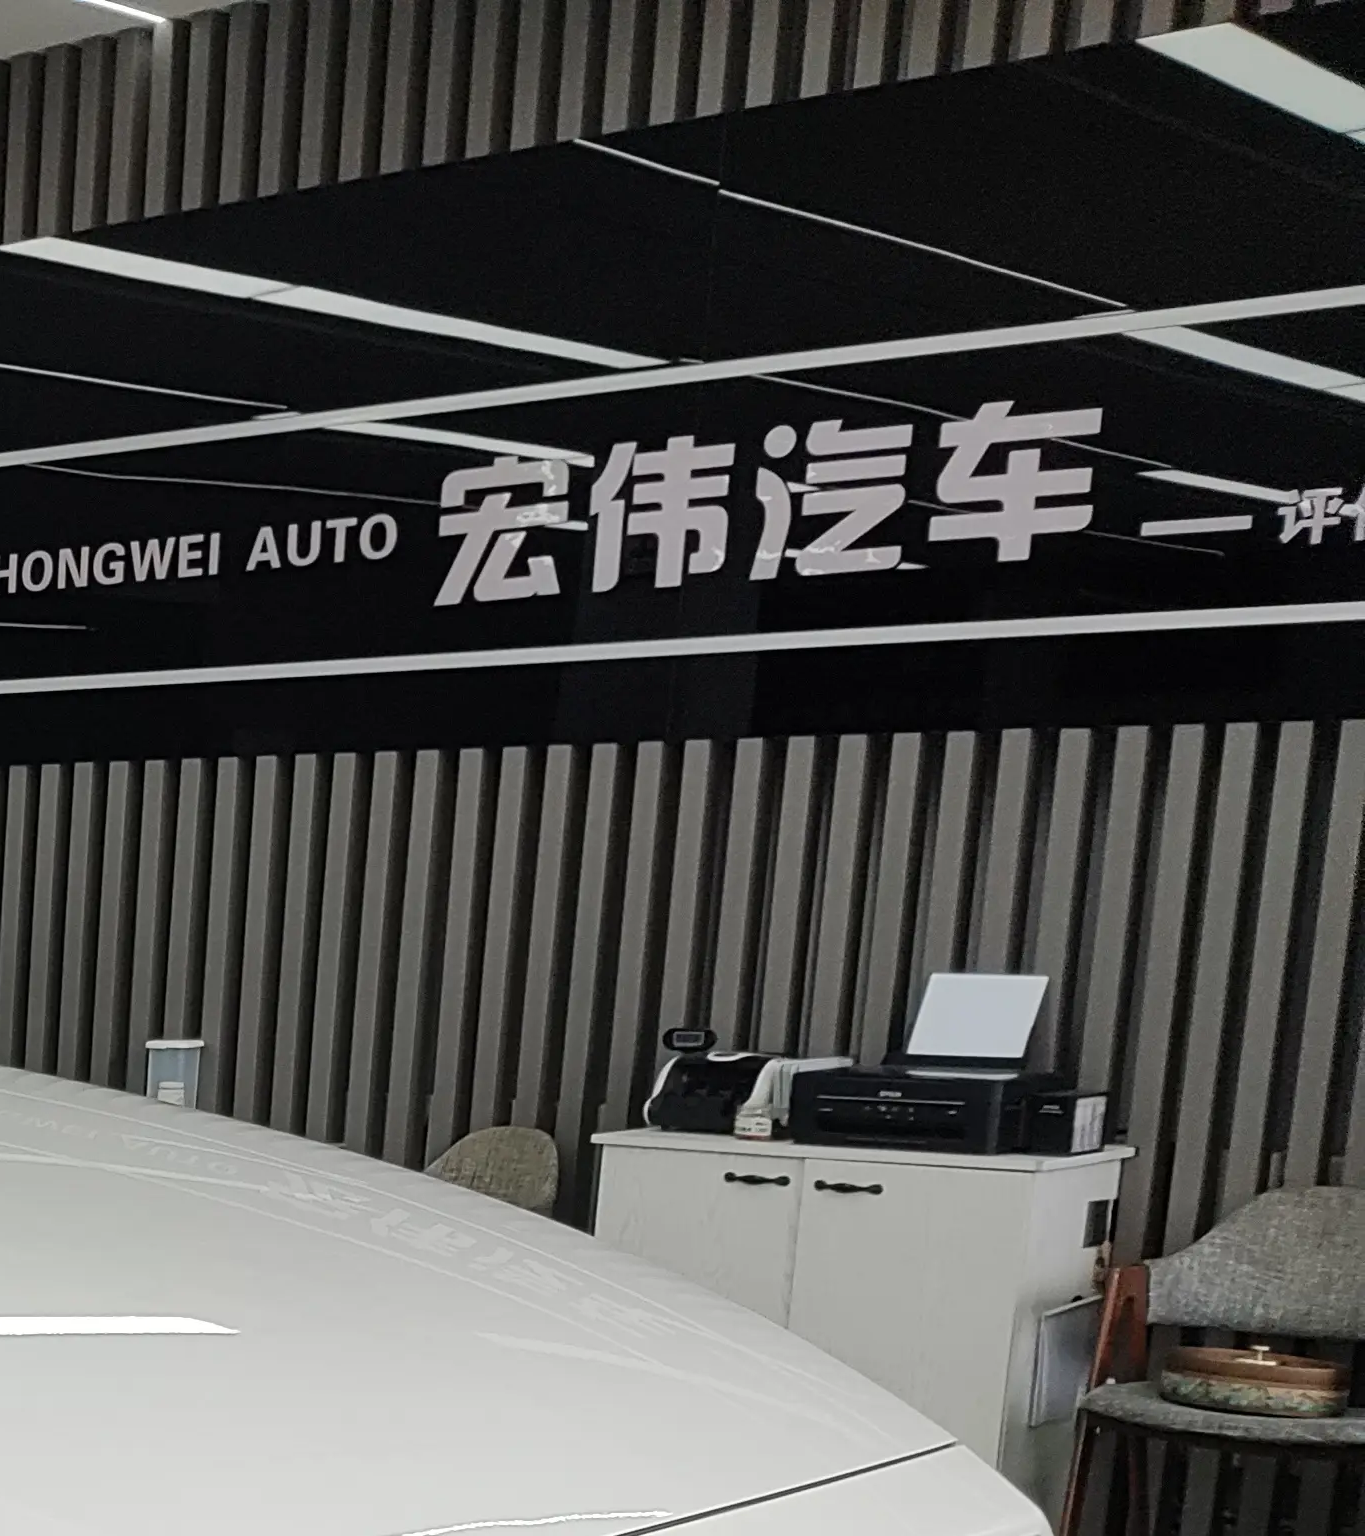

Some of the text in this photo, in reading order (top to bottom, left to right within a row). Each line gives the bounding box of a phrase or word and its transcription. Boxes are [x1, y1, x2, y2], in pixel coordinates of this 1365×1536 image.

[245, 512, 399, 572] AUTO
[432, 400, 1104, 607] 宏伟汽车
